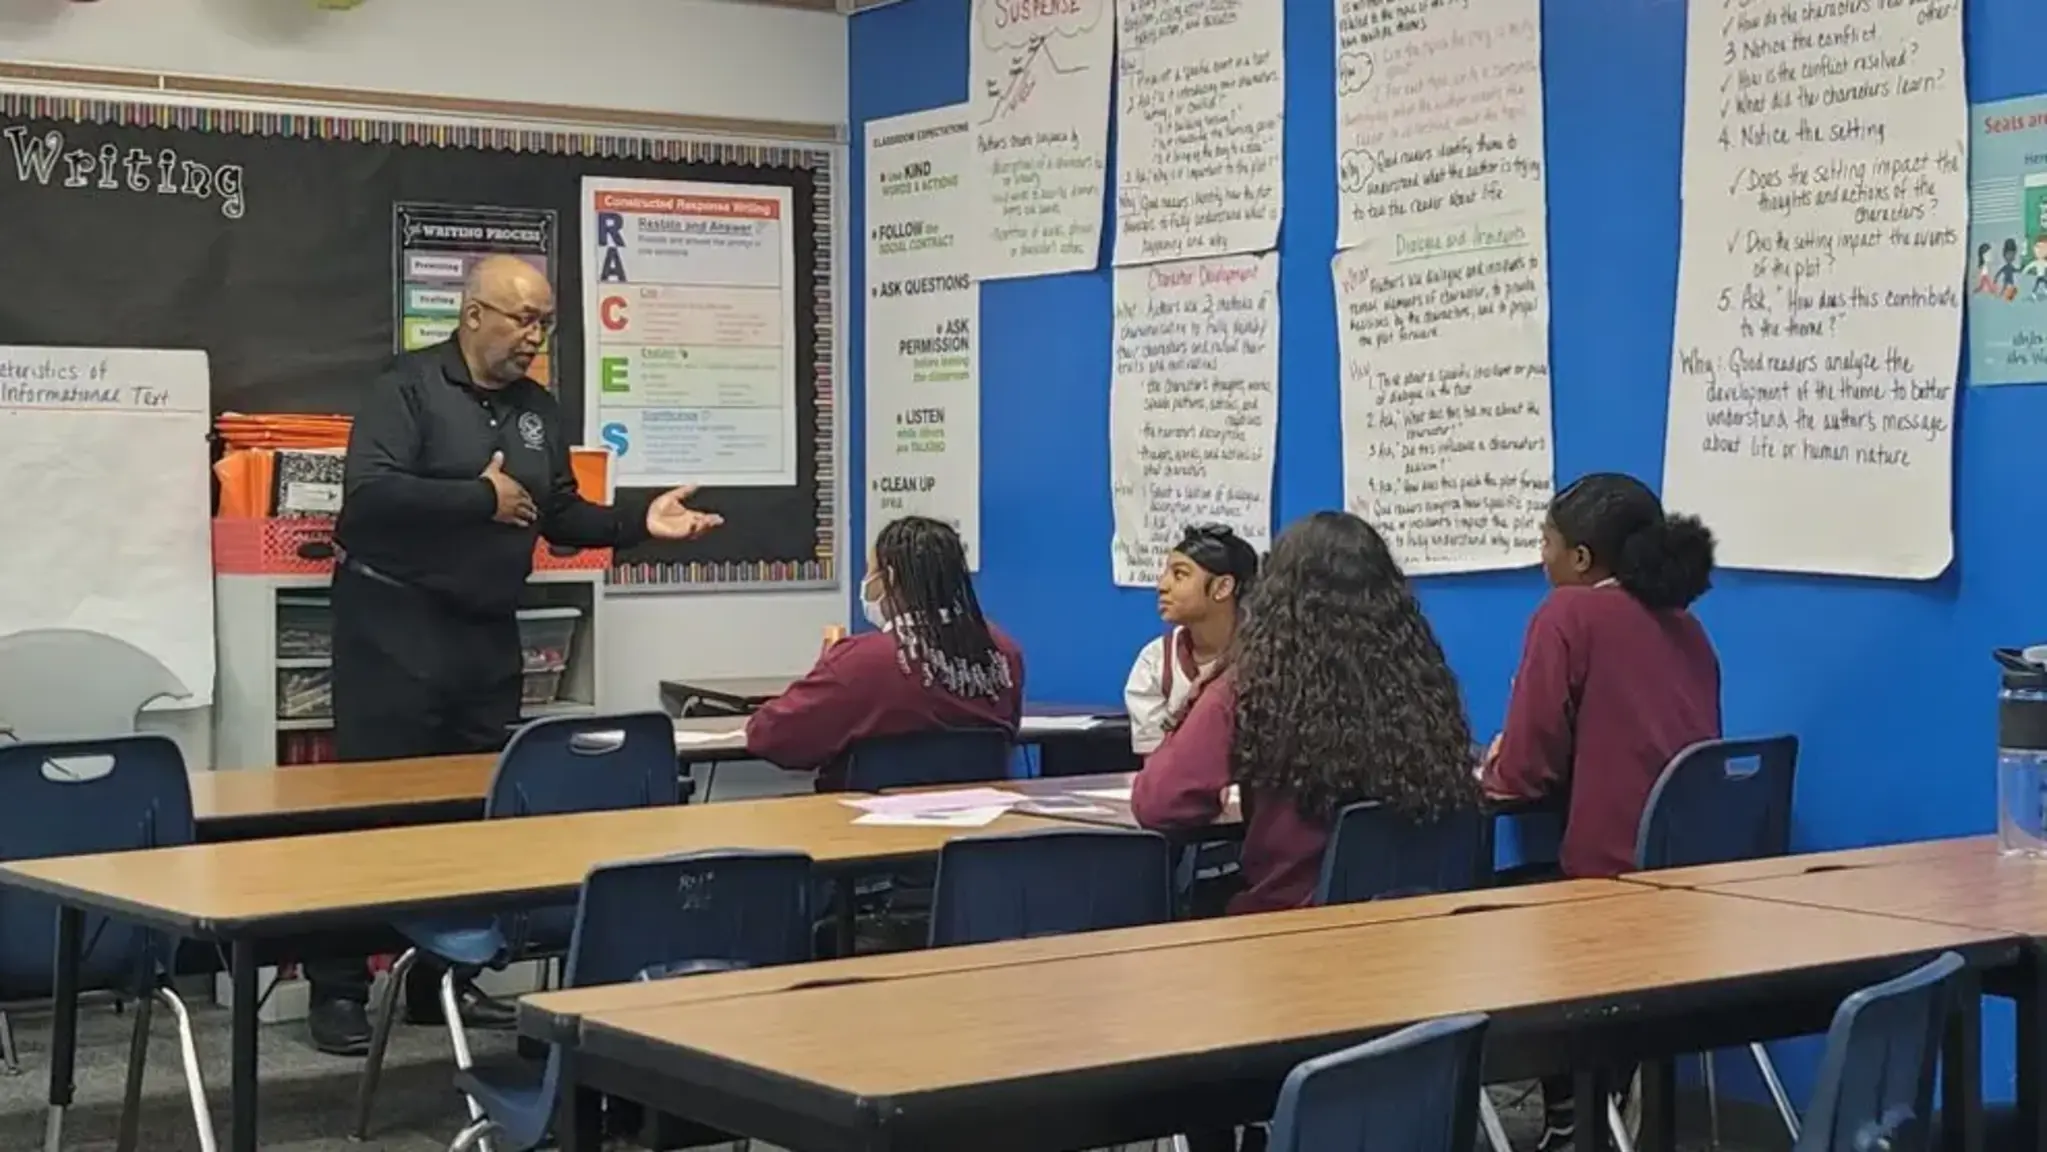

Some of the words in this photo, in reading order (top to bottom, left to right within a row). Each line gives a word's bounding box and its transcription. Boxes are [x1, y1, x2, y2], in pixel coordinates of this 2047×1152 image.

[1780, 5, 1796, 23] the
[1742, 36, 1785, 59] Notice
[1791, 32, 1811, 49] the
[1818, 22, 1876, 46] conflict
[1737, 70, 1762, 89] How
[1766, 68, 1777, 84] is
[1778, 60, 1796, 80] the
[1801, 56, 1848, 79] conflict
[1853, 41, 1919, 70] resolved?
[1736, 93, 1764, 115] What
[1771, 87, 1791, 109] did
[1798, 81, 1819, 104] the
[1822, 80, 1889, 105] characters
[1896, 68, 1945, 95] learn?
[873, 132, 915, 148] CLASSROOM
[918, 122, 969, 141] EXPECTATIONS
[1741, 125, 1790, 146] Notice
[1795, 118, 1823, 142] the
[1830, 118, 1885, 143] setting
[1984, 116, 2024, 134] Seats
[4, 126, 244, 218] Writing
[904, 161, 931, 178] KIND
[1423, 168, 1446, 185] what
[1448, 165, 1463, 179] the
[1467, 160, 1498, 177] author
[1501, 157, 1511, 172] is
[1747, 168, 1782, 191] Does
[1788, 163, 1809, 186] the
[1814, 159, 1865, 183] setting
[1872, 155, 1928, 180] impact
[1935, 154, 1959, 172] the
[882, 182, 912, 196] WORDS
[923, 174, 958, 190] ACTIONS
[1759, 189, 1811, 216] thoughts
[1815, 185, 1839, 206] and
[1842, 179, 1889, 204] actions
[1894, 177, 1907, 199] of
[1914, 176, 1935, 196] the
[604, 195, 673, 210] Constructed
[676, 199, 729, 212] Response
[733, 203, 771, 216] Writing
[1353, 204, 1364, 220] to
[1389, 199, 1407, 216] the
[1481, 181, 1503, 200] life
[1855, 199, 1939, 224] characters?
[423, 225, 483, 238] WRITING
[487, 228, 539, 241] PROCESS
[638, 218, 681, 231] Restate
[686, 221, 705, 232] and
[710, 223, 752, 234] Answer
[879, 220, 923, 240] FOLLOW
[879, 242, 906, 255] SOCIAL
[910, 235, 954, 250] CONTRACT
[1746, 231, 1771, 254] Does
[1777, 230, 1789, 250] the
[1794, 229, 1834, 250] setting
[1837, 229, 1882, 256] impact
[1890, 228, 1910, 245] the
[1914, 228, 1958, 244] events
[1753, 256, 1767, 277] of
[1771, 260, 1790, 278] the
[880, 283, 901, 297] ASK
[905, 274, 970, 294] QUESTIONS
[1819, 291, 1846, 309] does
[1851, 286, 1879, 308] this
[1885, 285, 1959, 308] contribute
[945, 318, 969, 334] ASK
[1740, 318, 1754, 337] to
[1760, 315, 1780, 336] the
[899, 337, 969, 354] PERMISSION
[90, 360, 107, 380] of
[914, 357, 938, 369] before
[941, 356, 969, 369] leaving
[1730, 348, 1764, 379] Good
[1768, 351, 1818, 371] readers
[1825, 350, 1878, 379] analyze
[1885, 350, 1914, 372] the
[913, 373, 926, 382] the
[2, 383, 119, 402] Informational
[131, 386, 168, 406] Text
[1707, 379, 1788, 402] development
[1798, 380, 1808, 399] of
[1815, 382, 1834, 399] the
[1840, 381, 1884, 399] theme
[1892, 379, 1908, 401] to
[1911, 377, 1951, 399] better
[906, 408, 944, 424] LISTEN
[1707, 407, 1788, 429] understand
[1794, 411, 1814, 429] the
[1883, 412, 1947, 442] message
[911, 442, 945, 453] TALKING
[1703, 436, 1740, 453] about
[1752, 436, 1774, 458] life
[1783, 443, 1796, 457] or
[1803, 443, 1848, 461] human
[1856, 445, 1910, 467] nature
[880, 477, 916, 492] CLEAN
[920, 476, 935, 492] UP
